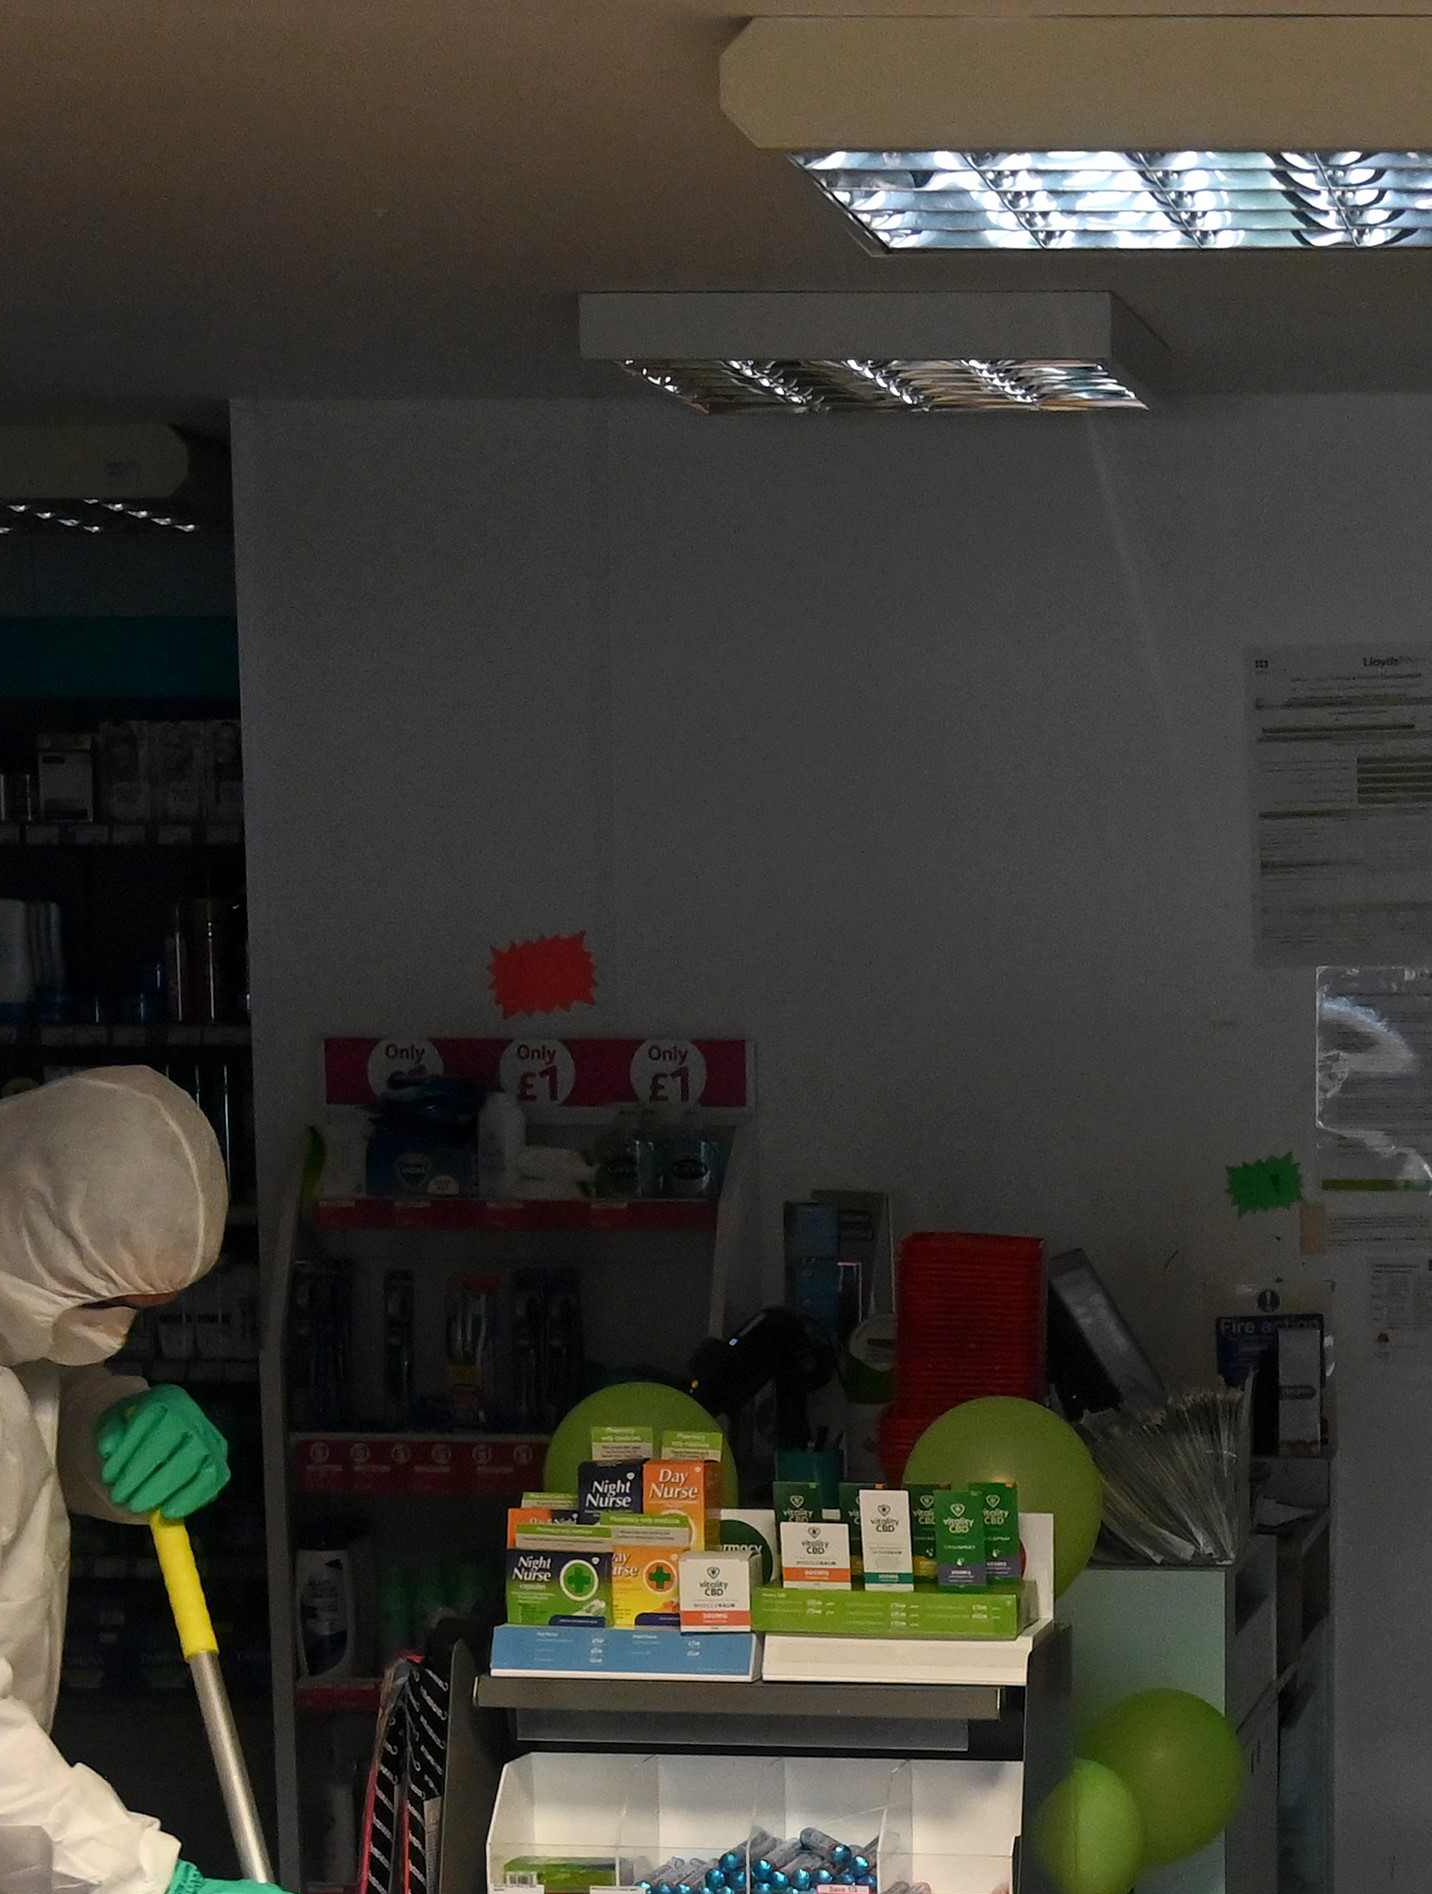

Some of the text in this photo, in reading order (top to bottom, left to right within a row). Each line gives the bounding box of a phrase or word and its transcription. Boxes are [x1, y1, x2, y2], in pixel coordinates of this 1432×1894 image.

[385, 1044, 425, 1061] Only
[517, 1044, 557, 1062] Only
[648, 1045, 688, 1063] Only
[519, 1067, 559, 1101] £1
[649, 1066, 690, 1102] £1
[659, 1468, 688, 1486] Day
[591, 1480, 632, 1497] Night
[649, 1483, 698, 1499] Nurse
[585, 1493, 632, 1508] Nurse
[875, 1523, 895, 1533] CBD
[806, 1546, 825, 1555] CBD
[518, 1555, 552, 1570] Night
[612, 1552, 631, 1565] ay
[512, 1568, 552, 1583] Nurse
[699, 1581, 728, 1590] vitality
[704, 1588, 724, 1597] CBD
